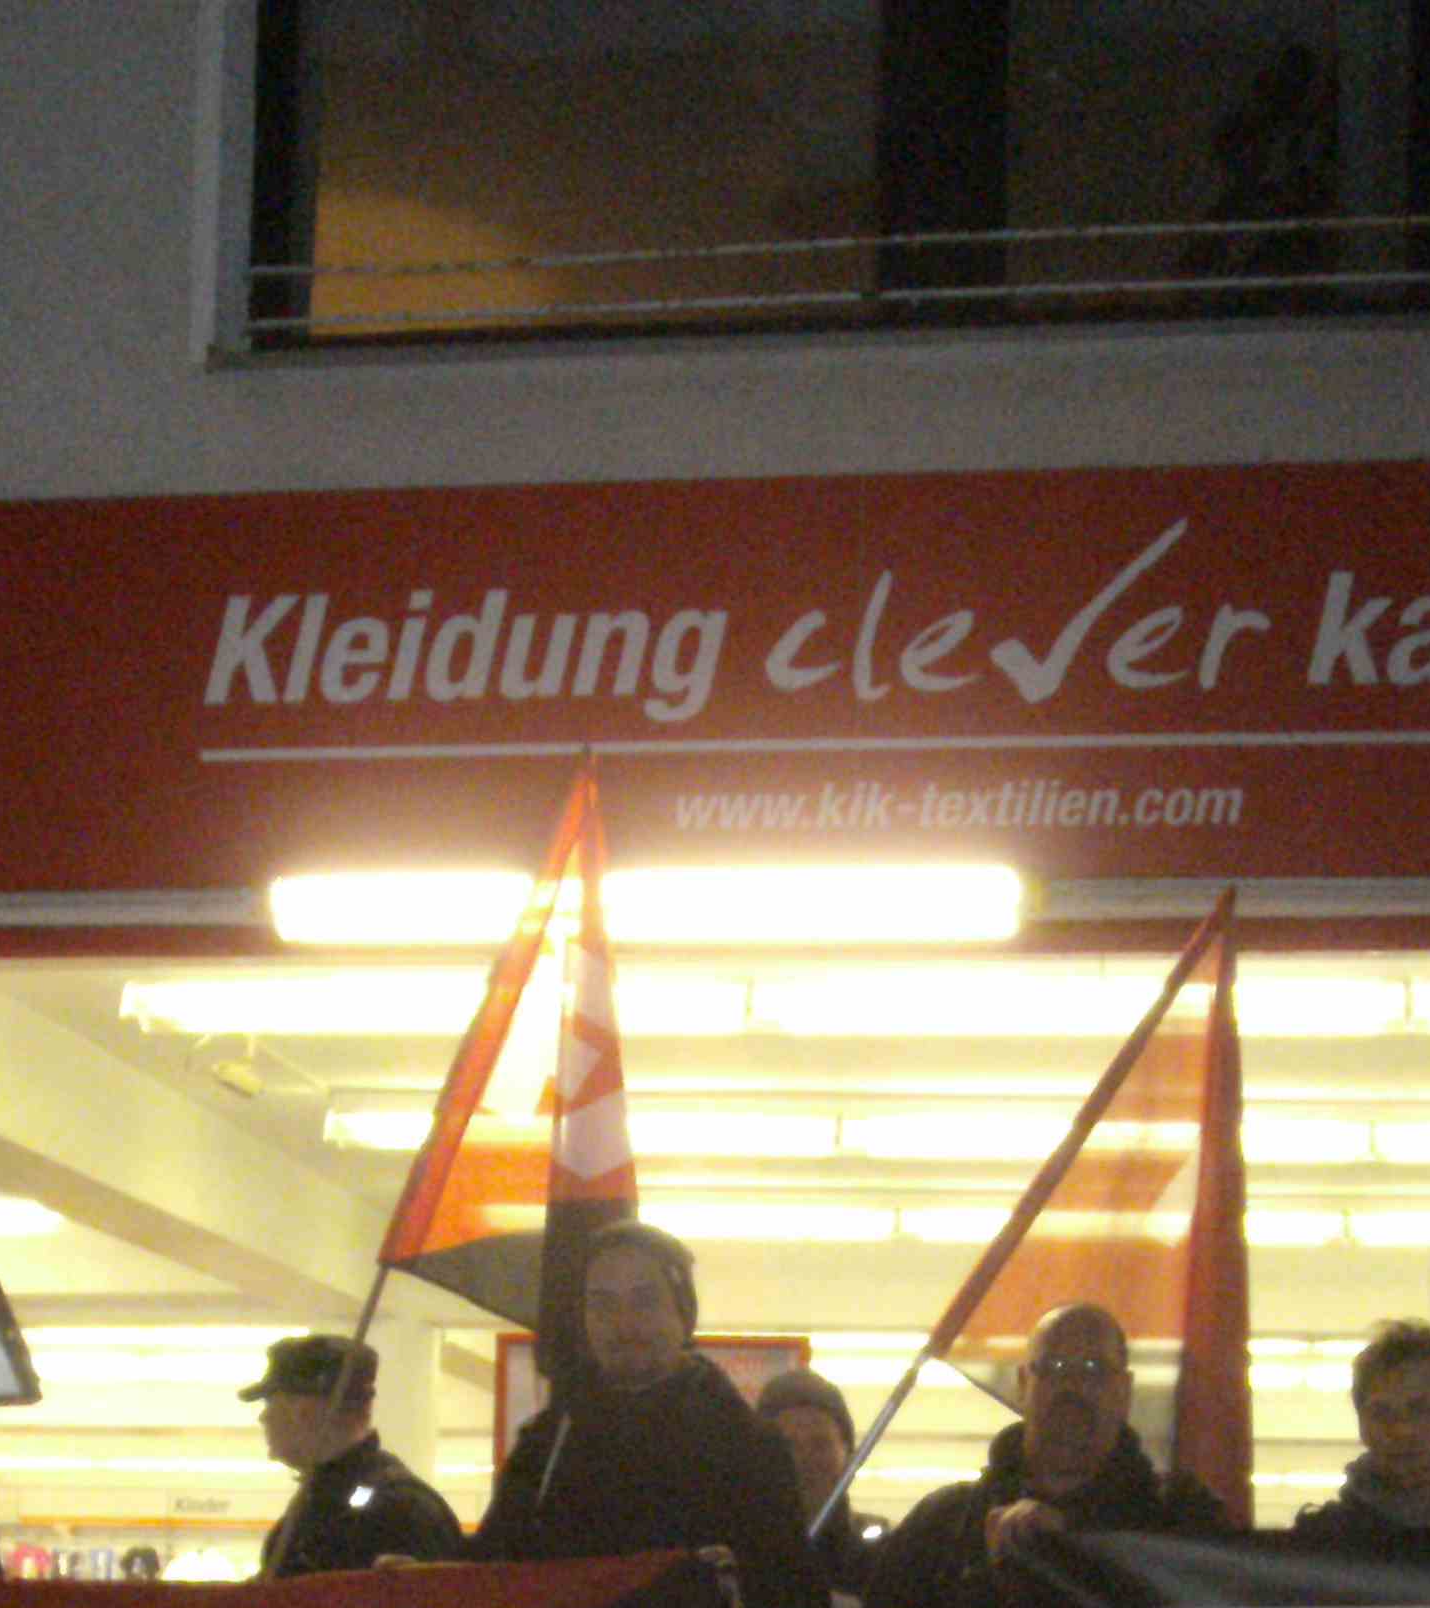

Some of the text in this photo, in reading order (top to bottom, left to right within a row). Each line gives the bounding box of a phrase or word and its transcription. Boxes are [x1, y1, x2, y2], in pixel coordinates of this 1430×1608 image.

[204, 588, 727, 723] Kleidung
[764, 516, 1269, 703] clever
[673, 781, 1244, 831] www.kik-textilien.com
